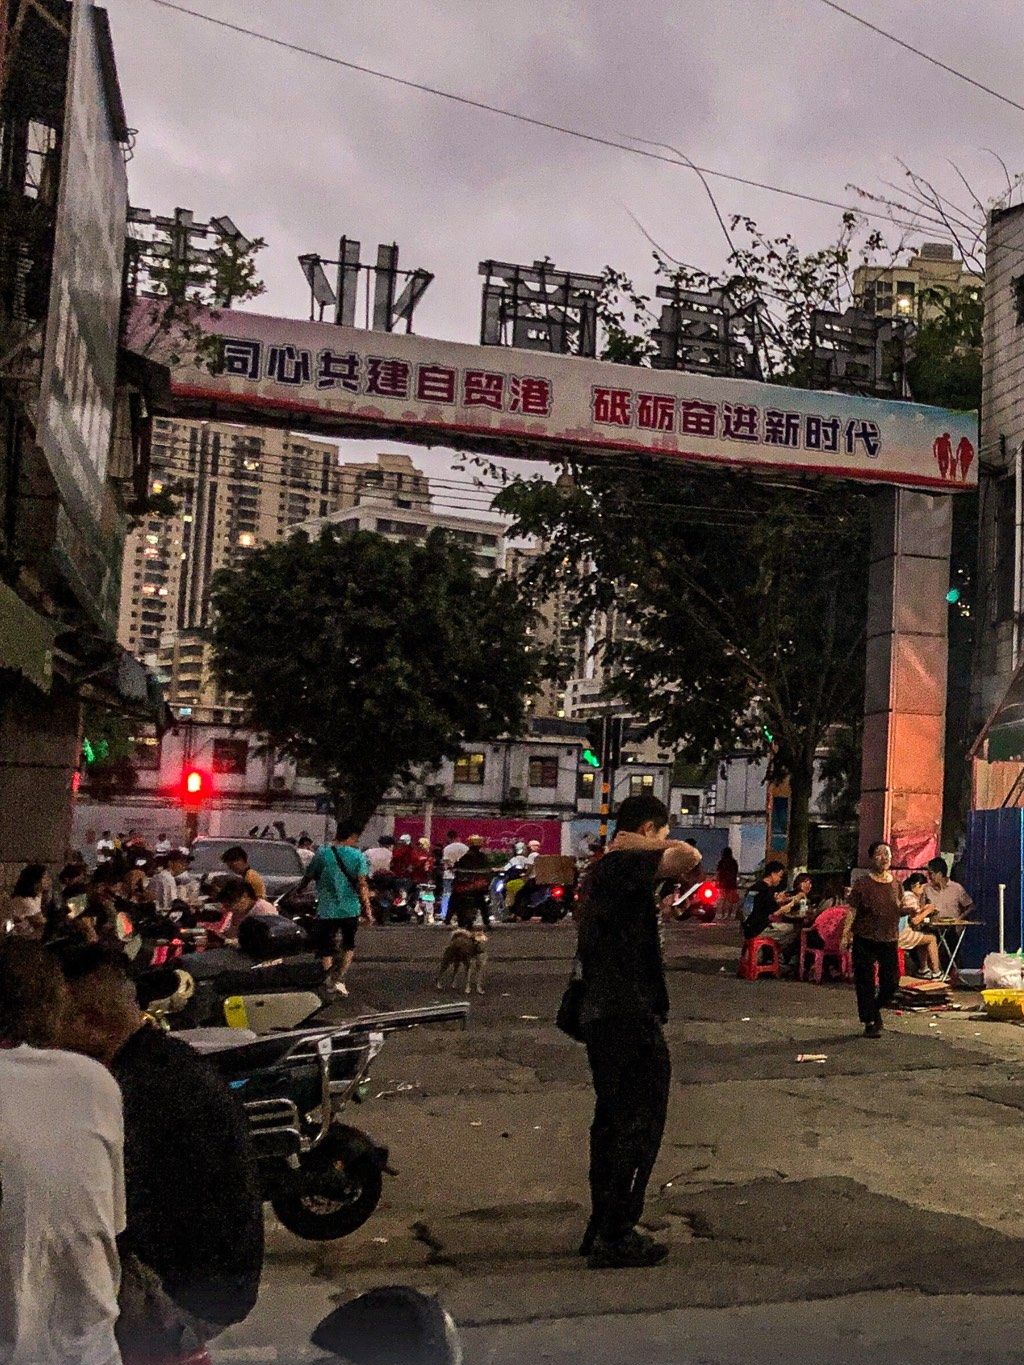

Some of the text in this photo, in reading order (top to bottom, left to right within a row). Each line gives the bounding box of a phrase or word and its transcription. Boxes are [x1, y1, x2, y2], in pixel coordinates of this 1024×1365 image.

[224, 338, 879, 457] 同心共建自贸港 砥砺奋进新时代
